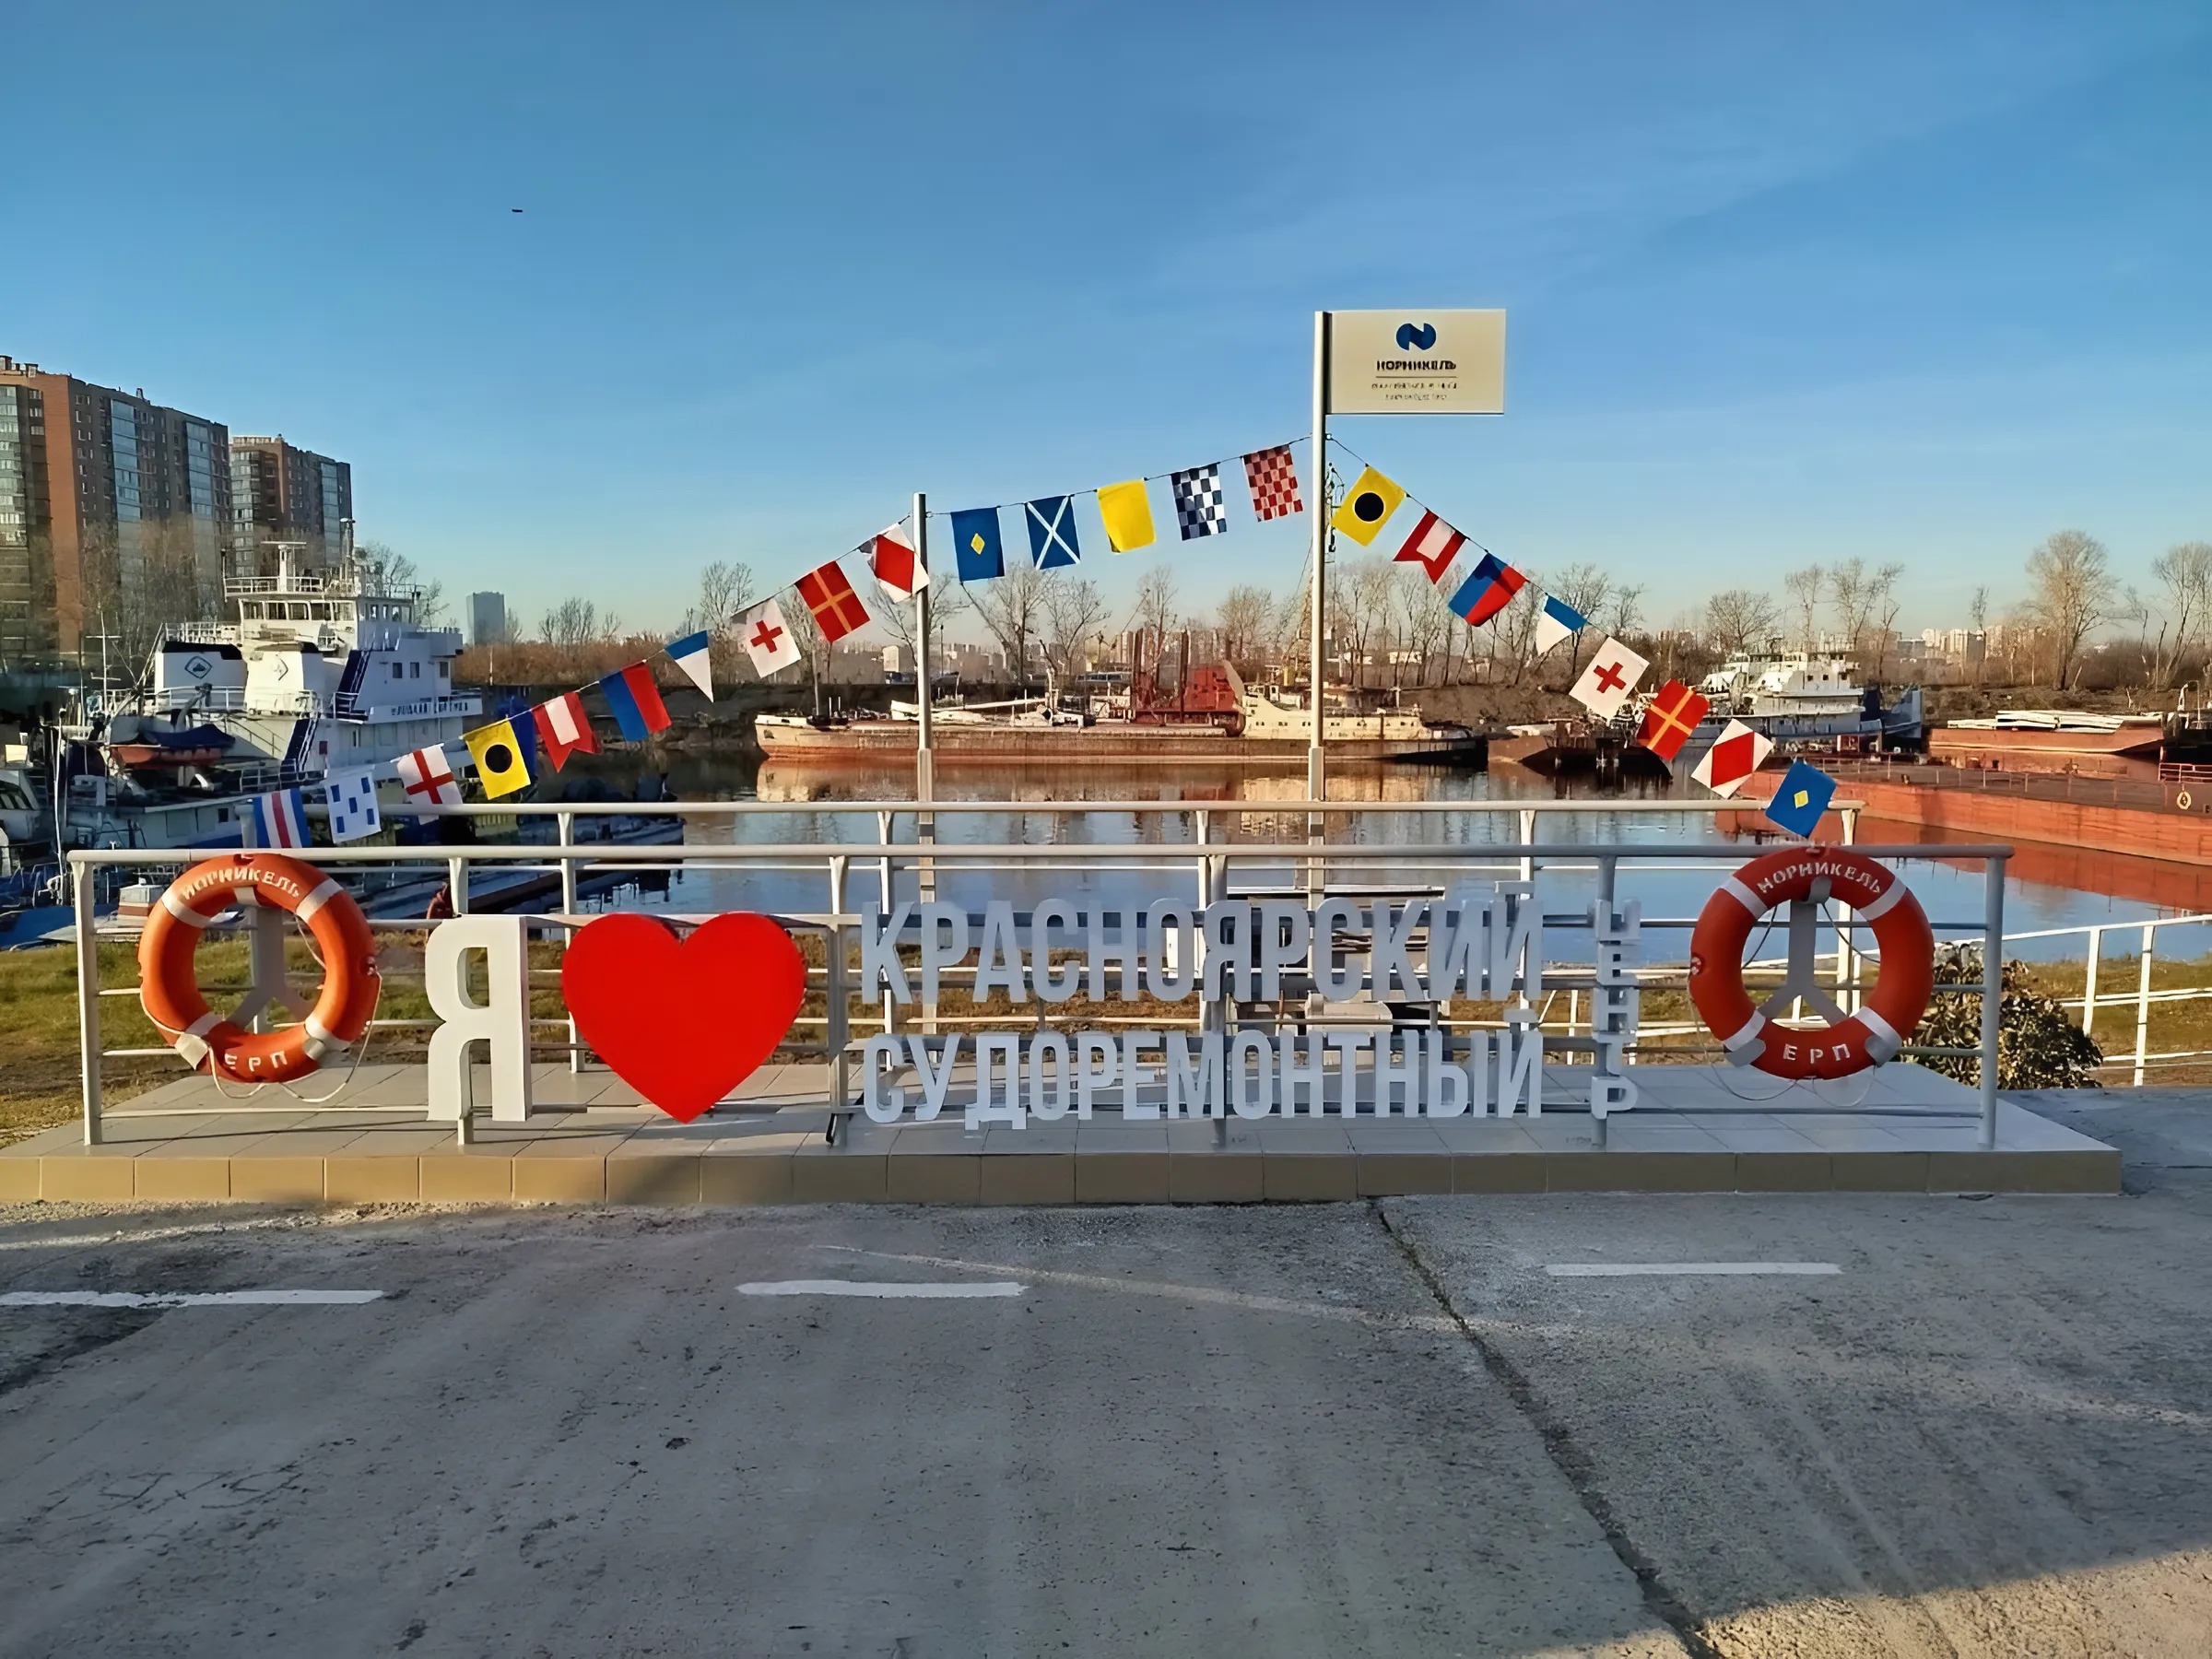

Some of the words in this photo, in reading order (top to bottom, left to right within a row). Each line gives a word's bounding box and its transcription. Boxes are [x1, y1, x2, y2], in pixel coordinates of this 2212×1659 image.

[1757, 862, 1881, 894] НОРНИКЕЛЬ
[862, 880, 1544, 1004] КРАСНОЯРСКИЙ
[224, 1050, 288, 1072] ЕРП
[426, 916, 532, 1122] Я
[864, 1008, 1544, 1130] СУДОРЕМОНТНЫЙ
[1592, 898, 1642, 1120] ЦЕНТР
[1783, 1043, 1851, 1064] ЕРП
